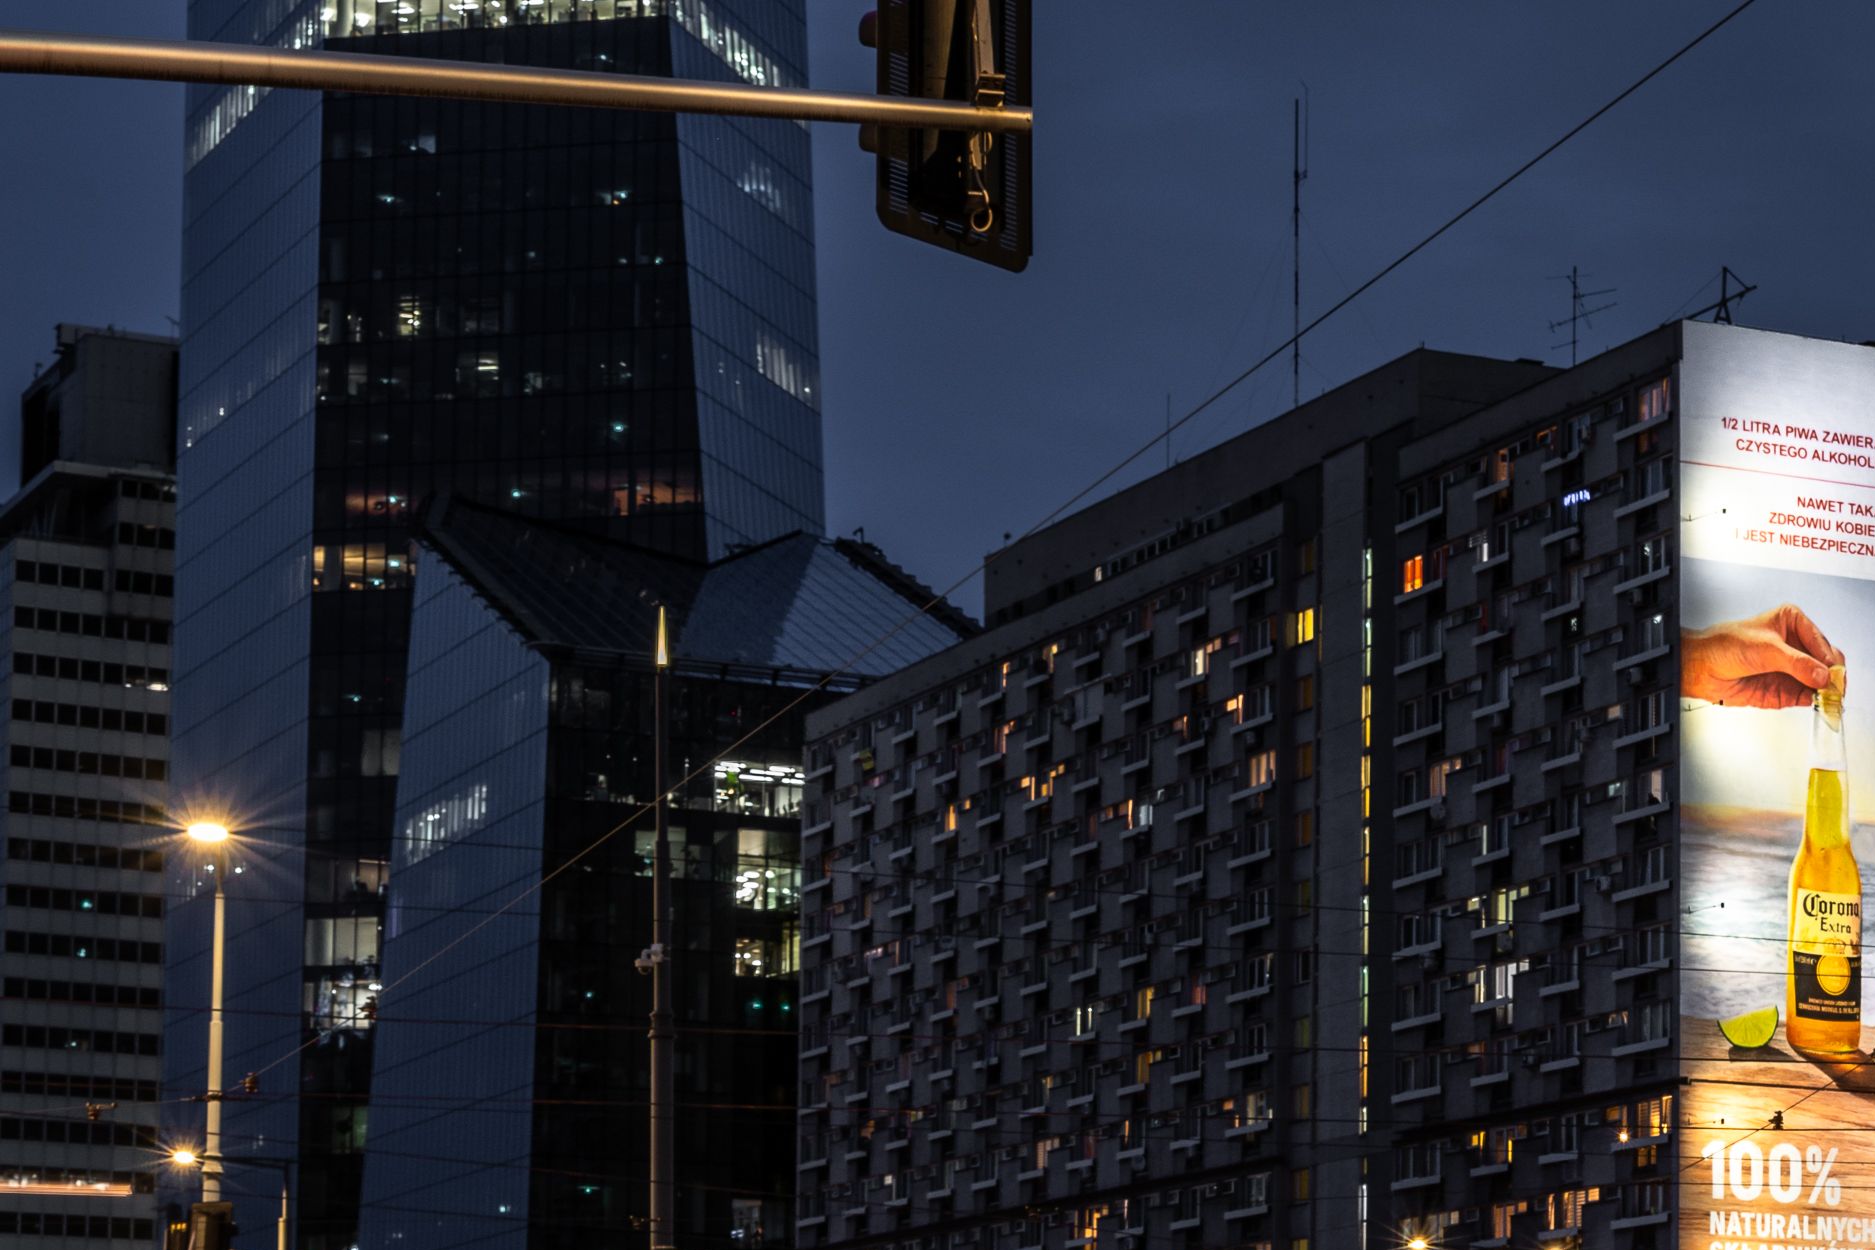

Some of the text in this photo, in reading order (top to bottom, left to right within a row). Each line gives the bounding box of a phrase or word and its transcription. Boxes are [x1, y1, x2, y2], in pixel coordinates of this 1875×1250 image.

[1721, 416, 1739, 431] 1/2
[1742, 419, 1781, 436] LITRA
[1785, 425, 1819, 442] PIWA
[1735, 438, 1808, 460] CZYSTEGO
[1796, 496, 1845, 513] NAWET
[1768, 511, 1831, 531] ZDROWIU
[1743, 528, 1776, 544] JEST
[1802, 892, 1860, 921] Corona
[1820, 916, 1852, 934] Extra
[1701, 1139, 1841, 1207] 100%
